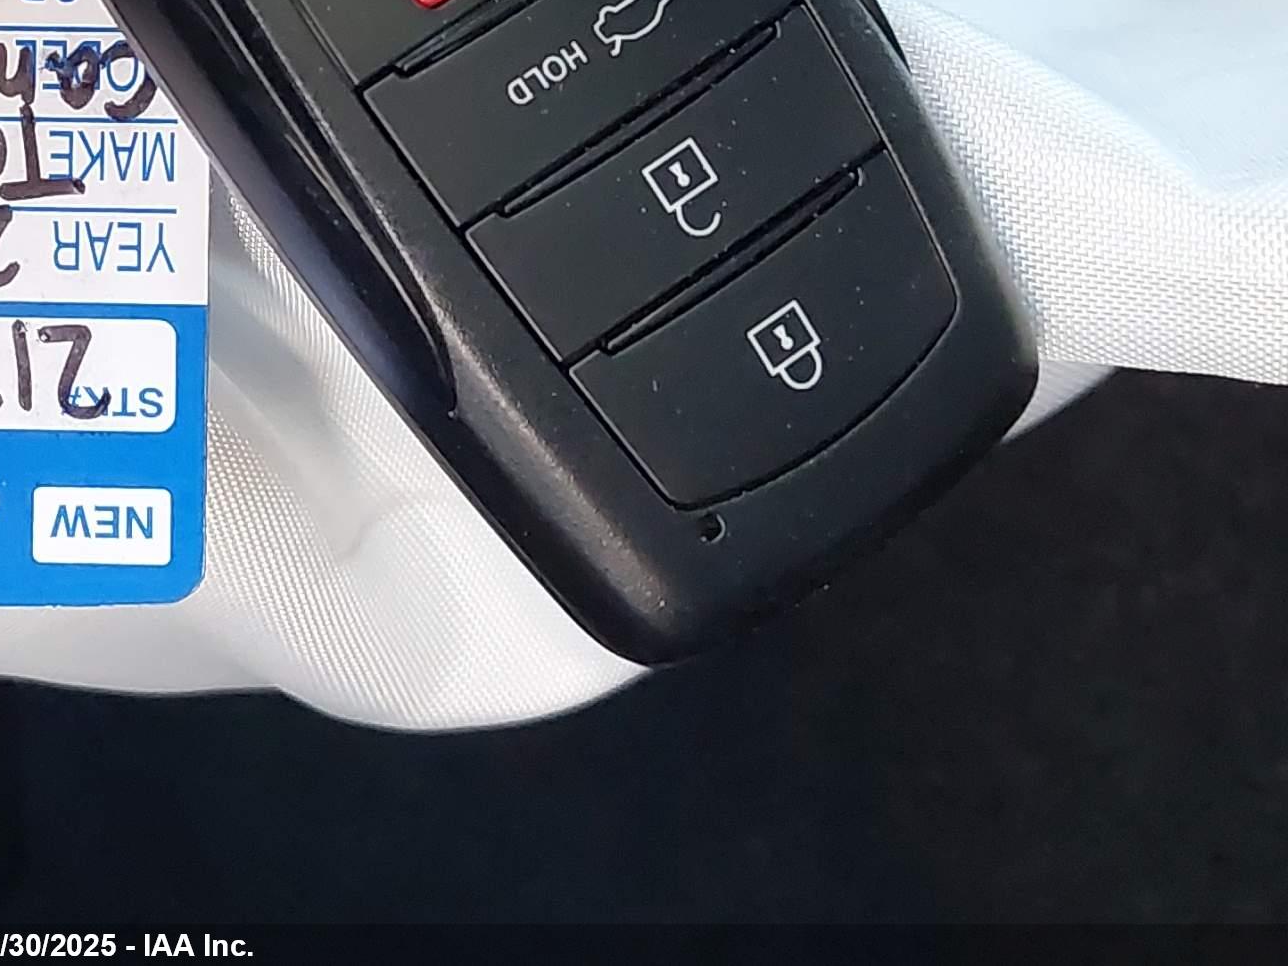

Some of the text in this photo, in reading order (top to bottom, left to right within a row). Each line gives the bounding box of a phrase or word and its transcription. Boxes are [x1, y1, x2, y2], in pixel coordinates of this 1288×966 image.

[15, 39, 141, 92] ODEL
[507, 40, 588, 105] HOLD
[48, 129, 175, 182] MAKE
[52, 220, 175, 273] YEAR
[50, 504, 154, 540] NEW
